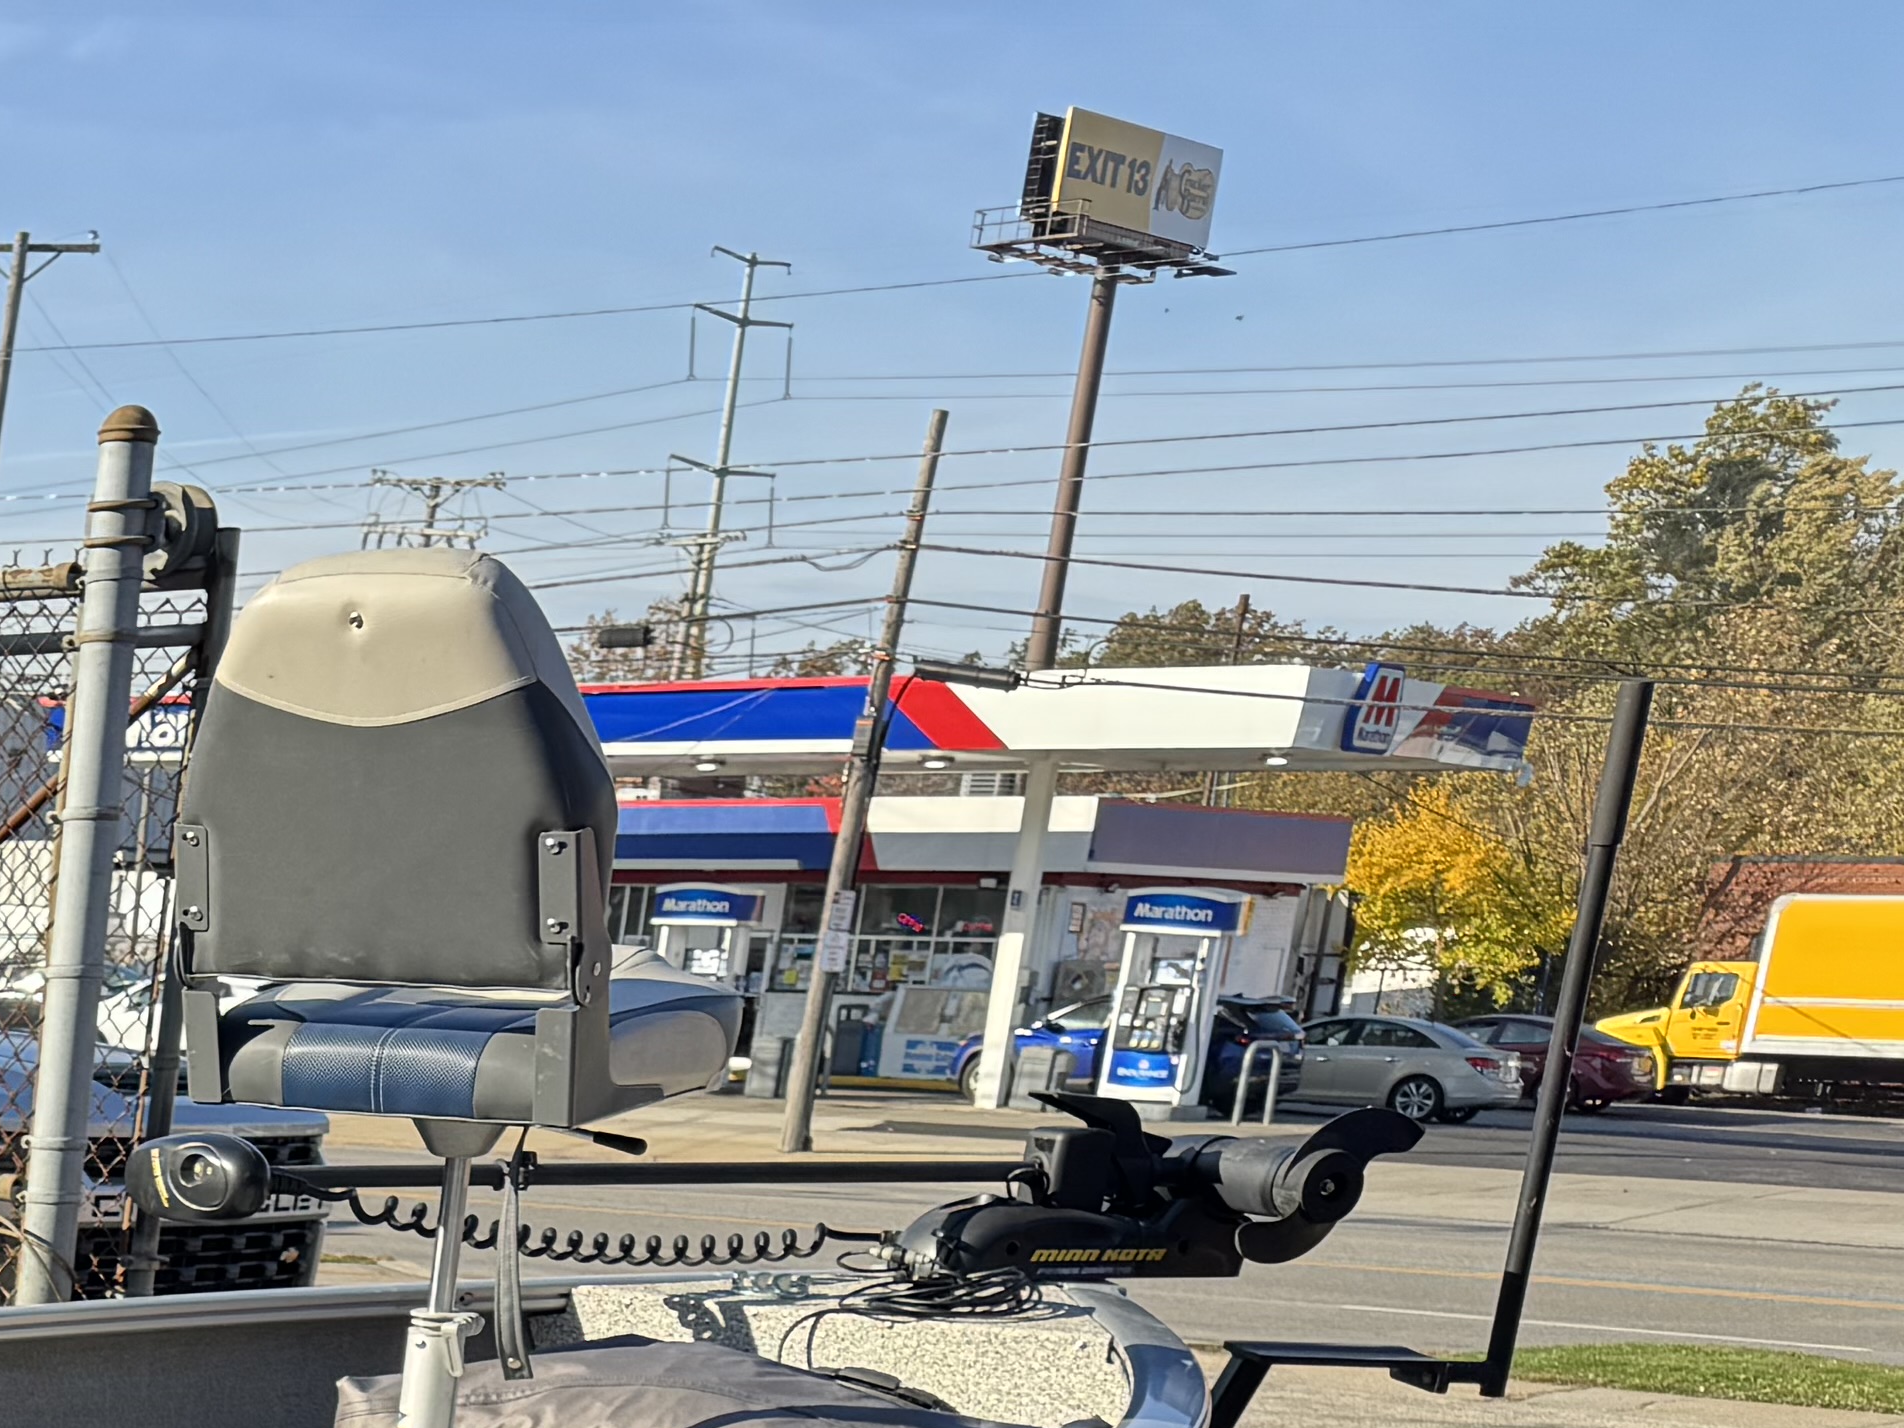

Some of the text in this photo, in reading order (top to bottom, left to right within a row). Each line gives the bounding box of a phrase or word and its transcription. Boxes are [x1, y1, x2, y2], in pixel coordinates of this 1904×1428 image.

[1066, 142, 1152, 197] EXIT 13
[662, 898, 730, 913] Marathon
[1133, 902, 1214, 923] Marathon
[1030, 1248, 1167, 1263] MINN KOTA
